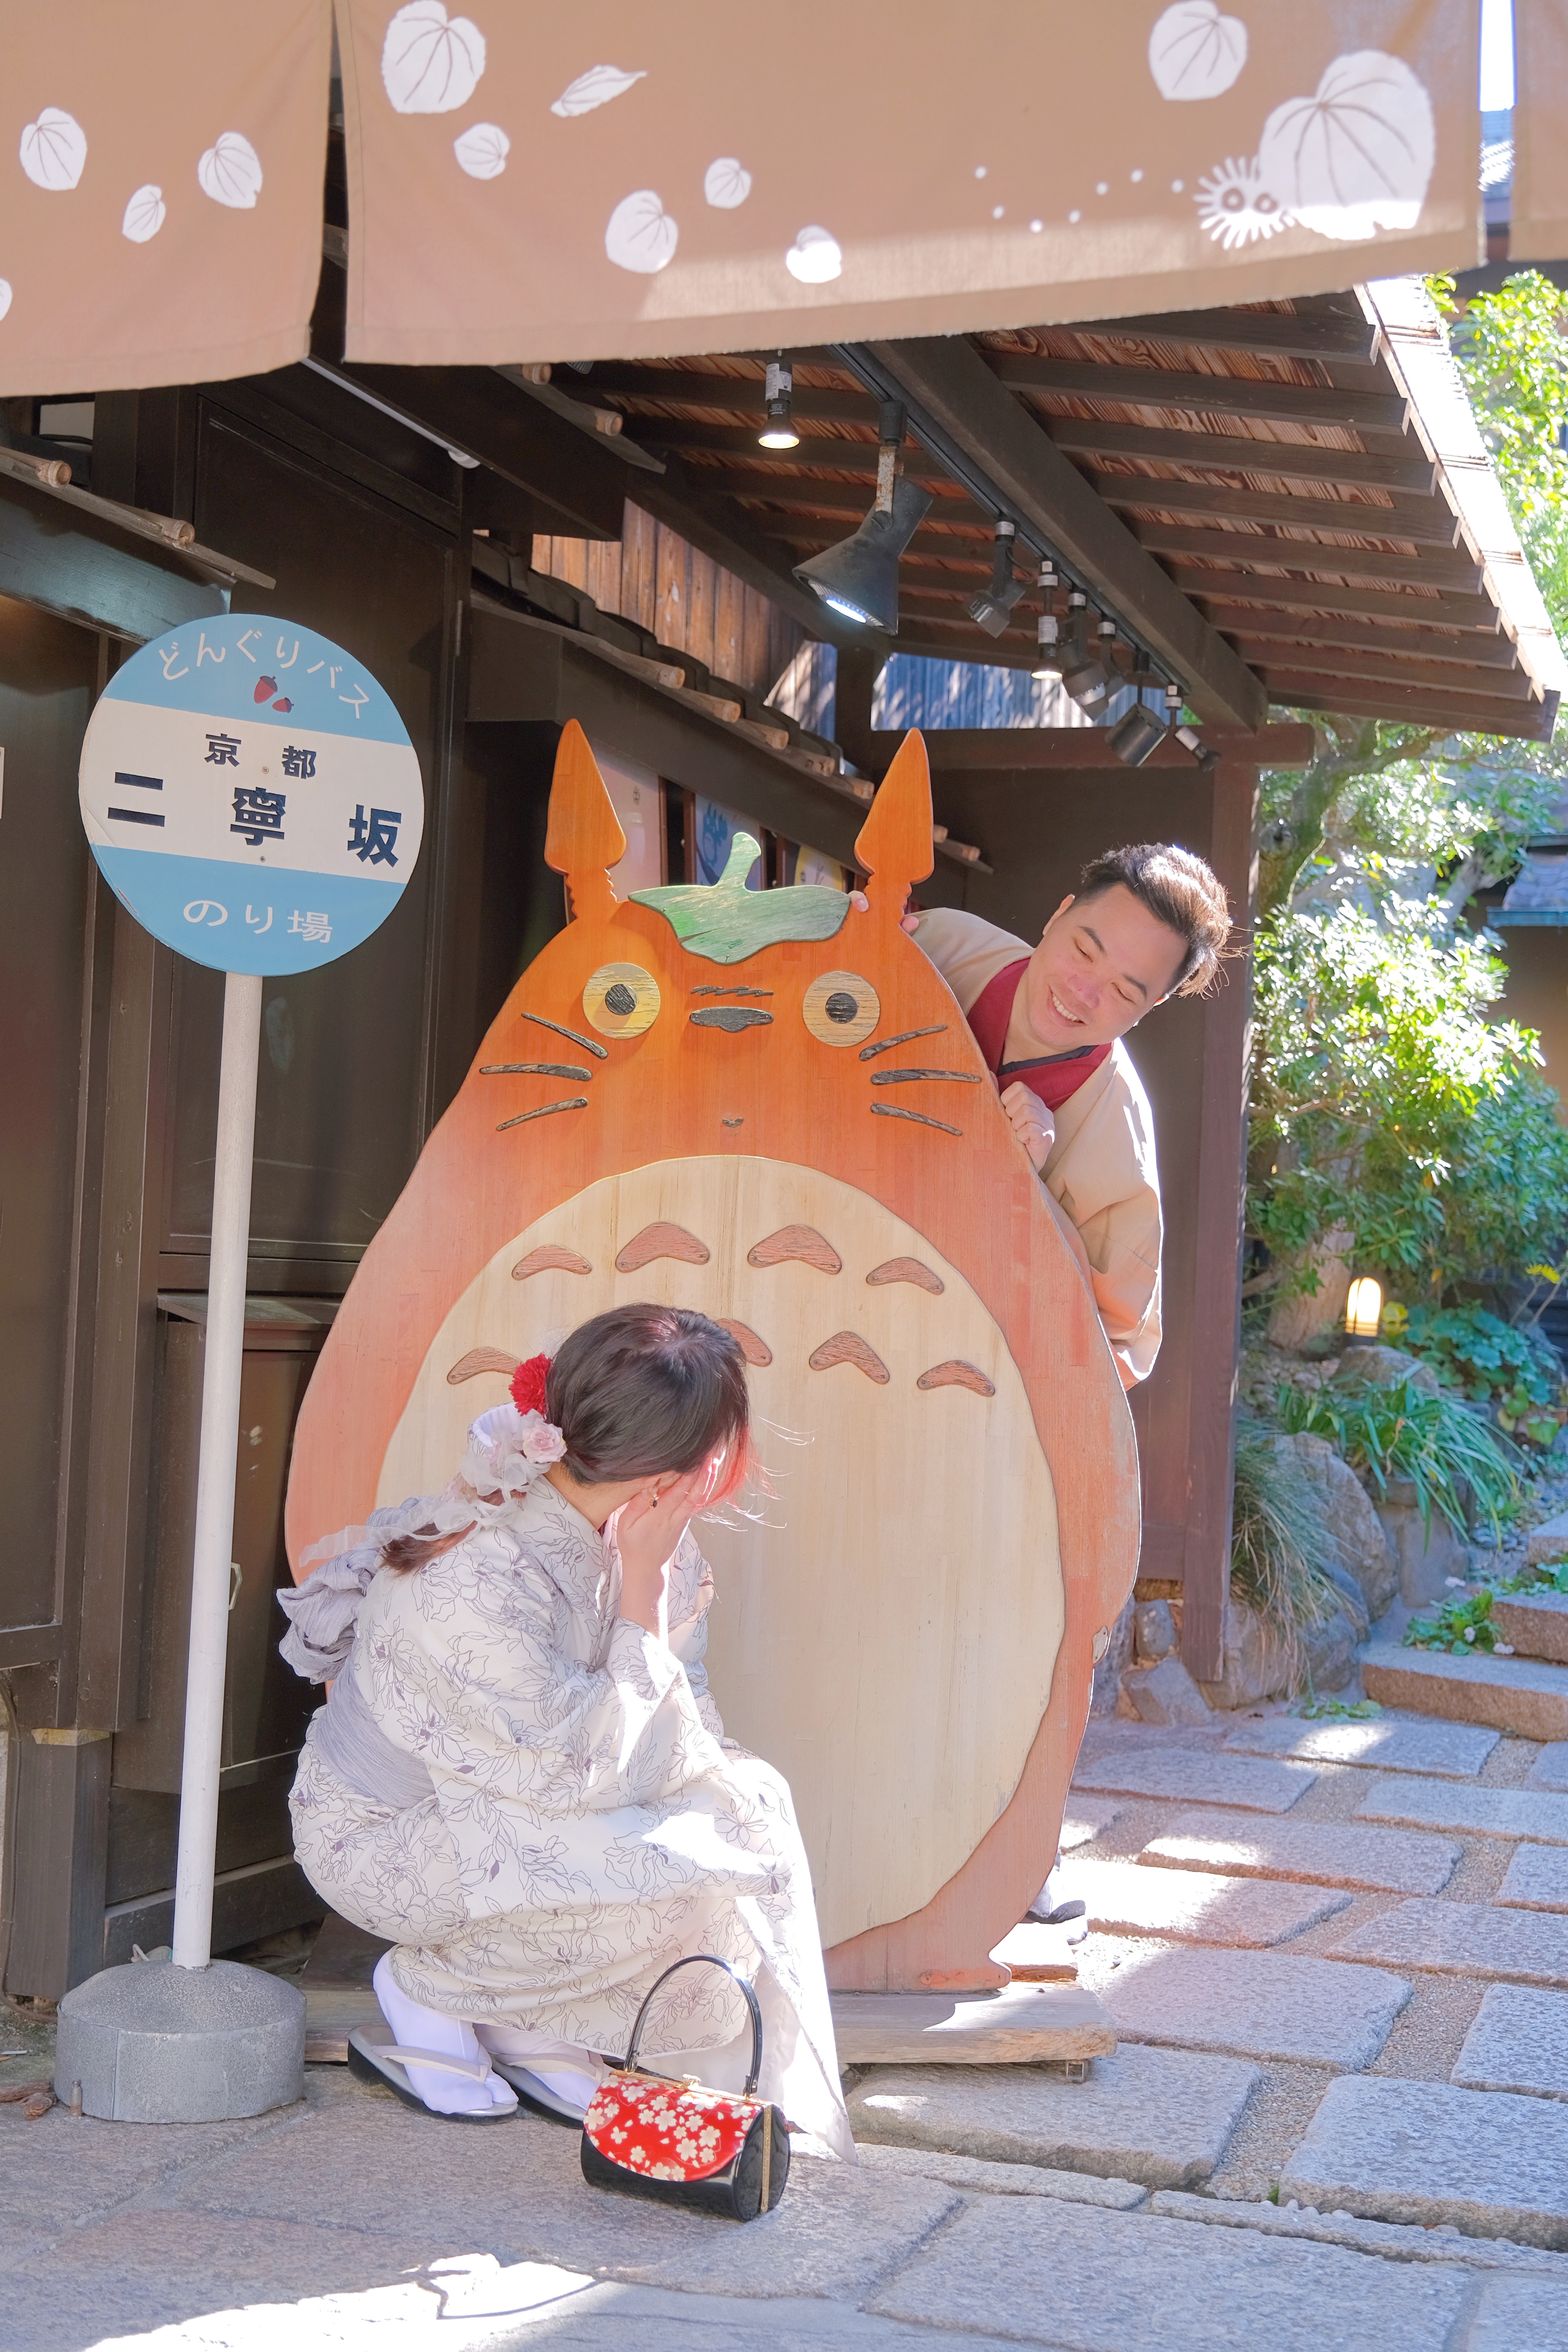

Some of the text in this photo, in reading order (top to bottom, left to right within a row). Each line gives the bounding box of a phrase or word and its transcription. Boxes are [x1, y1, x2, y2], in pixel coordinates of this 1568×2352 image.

[159, 629, 369, 719] どんぐりバス
[204, 733, 317, 779] 京都
[107, 772, 401, 868] 二寧坂
[183, 900, 333, 943] のり場
